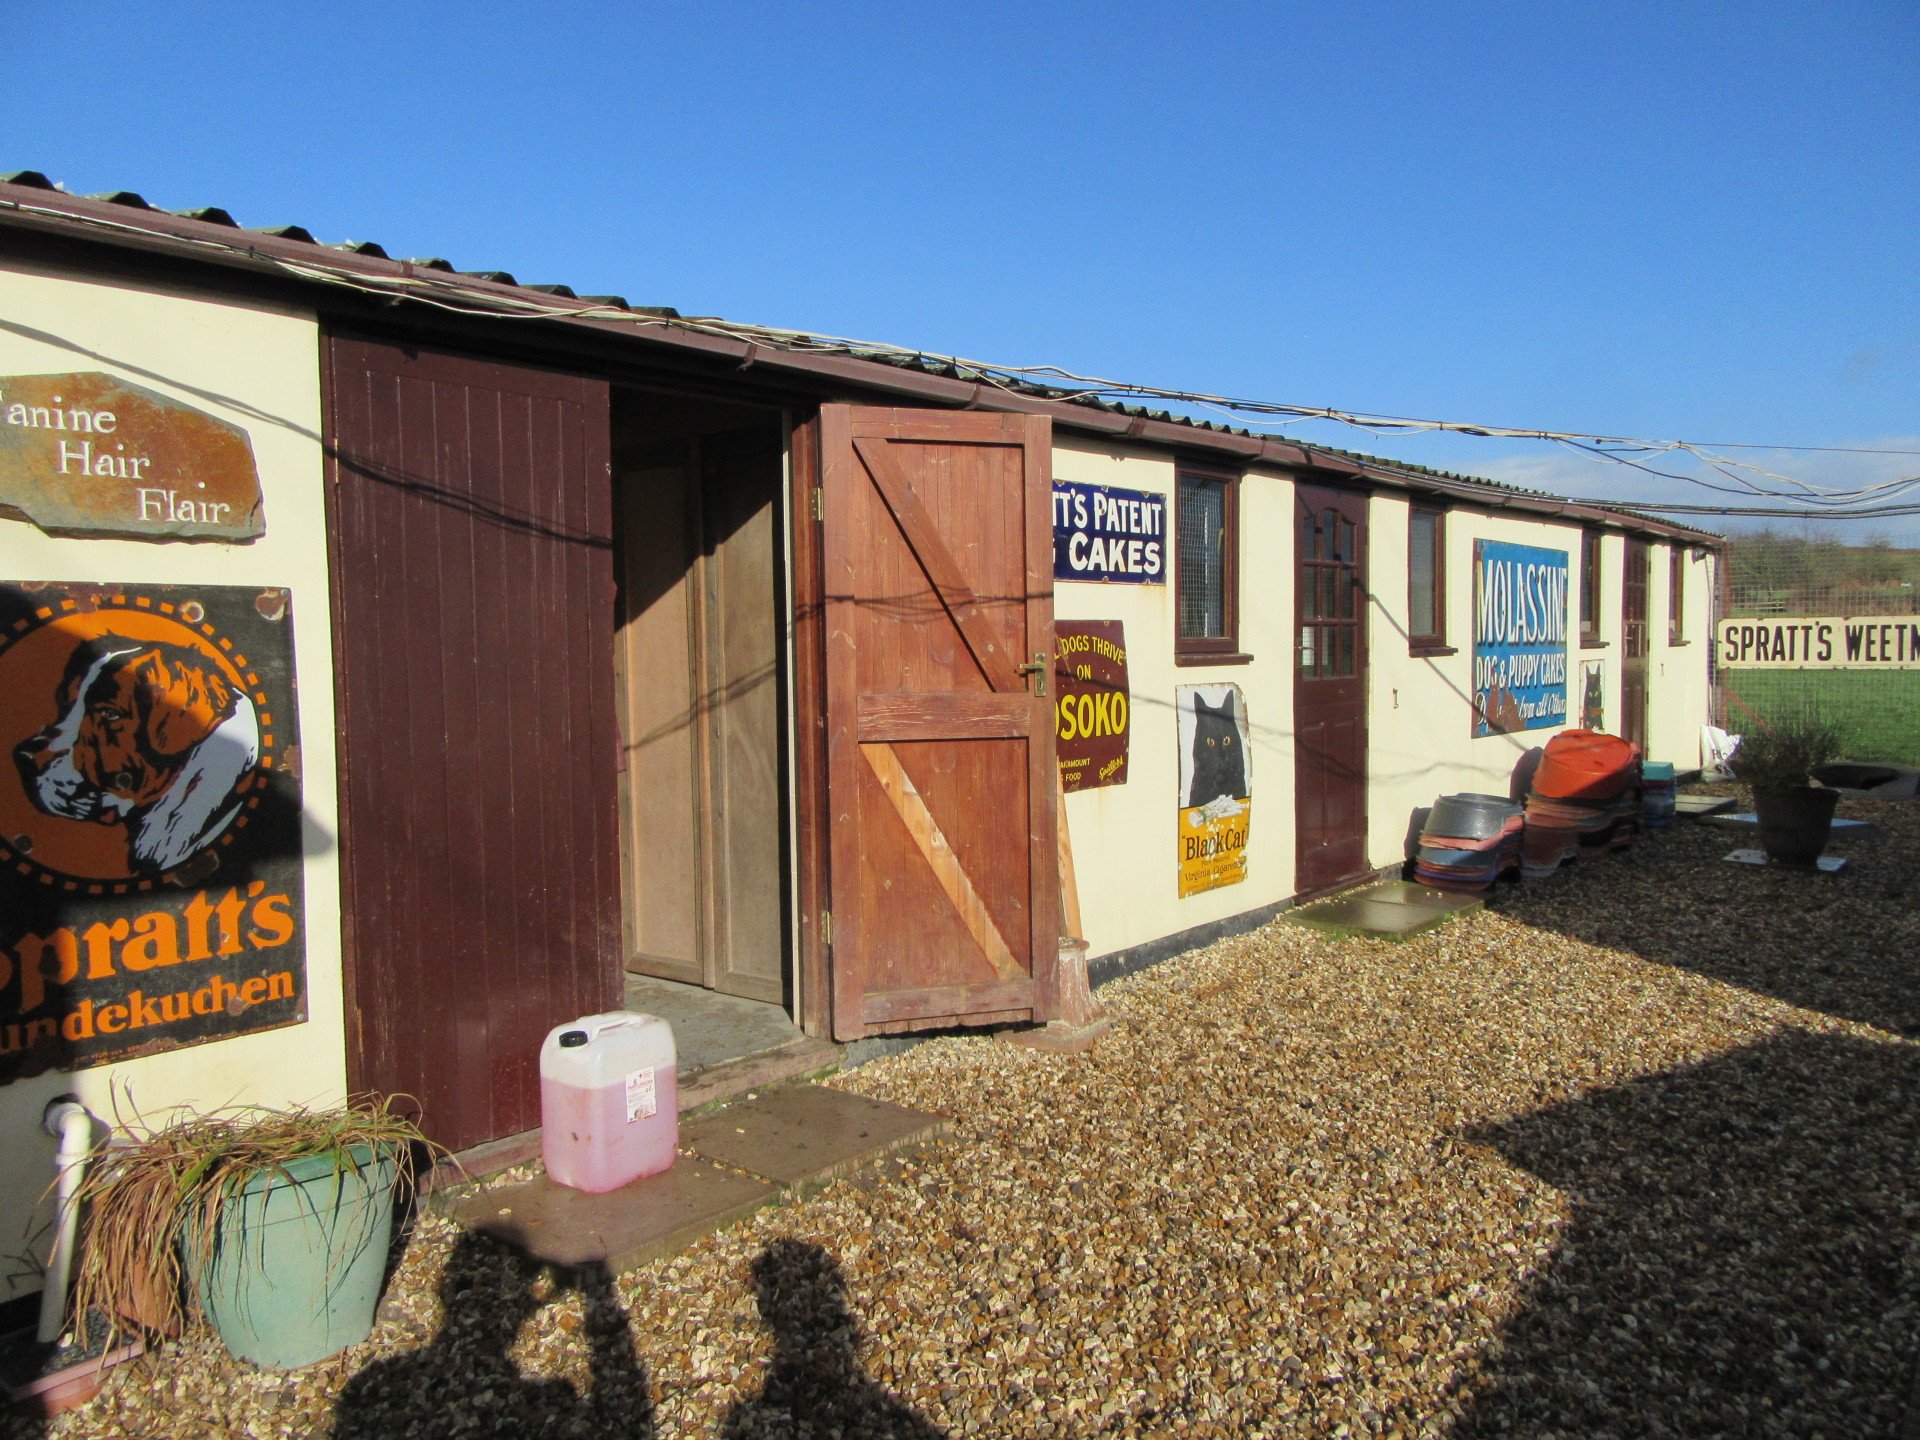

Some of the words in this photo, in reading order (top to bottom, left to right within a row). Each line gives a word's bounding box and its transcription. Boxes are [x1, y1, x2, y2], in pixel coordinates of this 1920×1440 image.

[0, 391, 117, 433] anine
[58, 440, 150, 479] Hair
[136, 481, 231, 524] Flair
[1093, 492, 1161, 535] PATENT
[1069, 531, 1161, 575] CAKES
[1476, 559, 1567, 644] MOLASSINE
[1061, 635, 1090, 655] DOGS
[1092, 636, 1126, 666] THRIVE
[1725, 621, 1833, 662] SPRATT'S
[1077, 664, 1092, 681] ON
[1476, 656, 1498, 690] DOG
[1500, 657, 1507, 689] &
[1508, 654, 1540, 687] PUPPY
[1541, 653, 1565, 686] CAKES
[1055, 691, 1127, 741] SOKO
[1059, 758, 1091, 769] ARAMOUNT
[1065, 772, 1082, 782] FOOD
[0, 881, 294, 1014] pratt's
